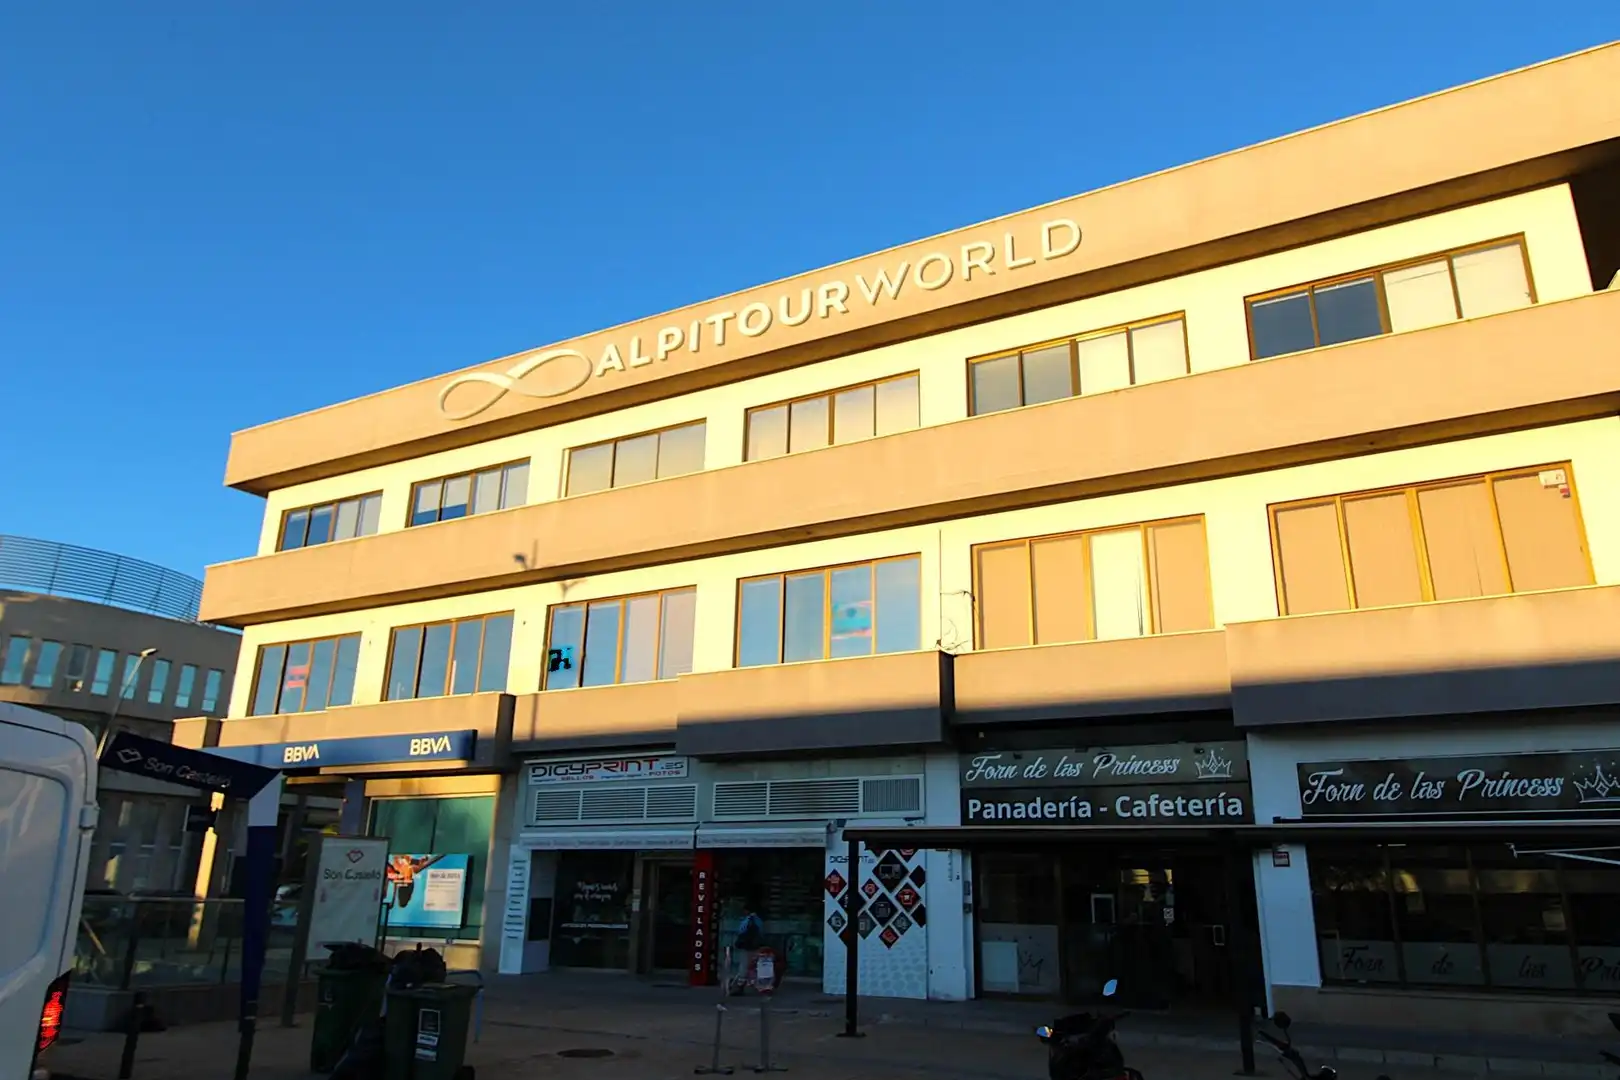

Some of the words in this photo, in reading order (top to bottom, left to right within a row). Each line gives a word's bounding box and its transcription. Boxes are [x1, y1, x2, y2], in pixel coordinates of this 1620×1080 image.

[283, 744, 320, 762] BBVA
[409, 735, 451, 756] BBVA
[144, 757, 174, 775] Son
[965, 754, 1018, 781] Forn
[1023, 755, 1048, 779] de
[1053, 756, 1084, 778] las
[1093, 753, 1181, 778] Princess
[1302, 768, 1367, 804] Forn
[1372, 772, 1403, 801] de
[1410, 771, 1446, 799] las
[1457, 768, 1564, 801] Princess
[968, 797, 1092, 819] Panadería
[1115, 792, 1243, 818] Cafetería
[694, 871, 706, 972] REVELADOS
